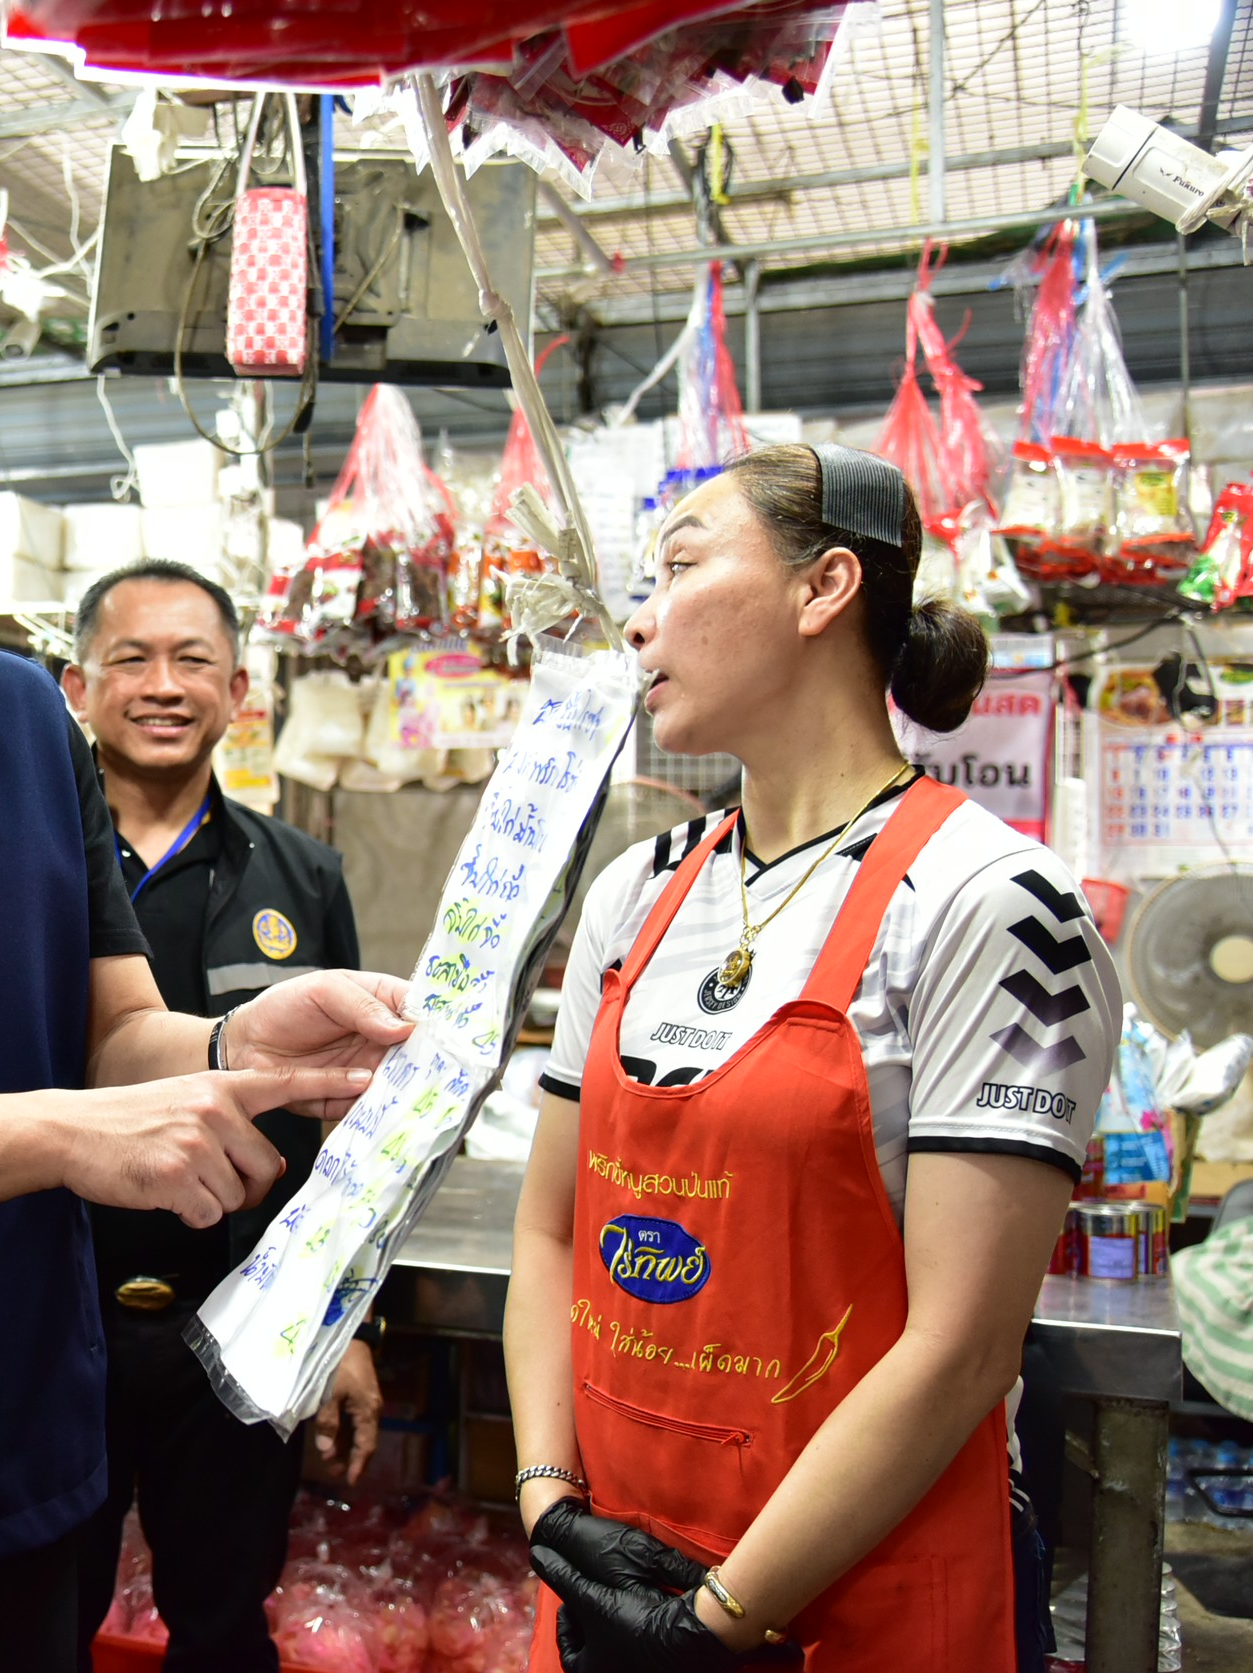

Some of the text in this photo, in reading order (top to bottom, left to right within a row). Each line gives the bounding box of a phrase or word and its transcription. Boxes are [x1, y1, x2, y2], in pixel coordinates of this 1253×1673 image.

[650, 1022, 733, 1051] JUST DO IT
[976, 1082, 1034, 1112] JUST
[1032, 1088, 1066, 1119] DO
[638, 1229, 661, 1244] ตรา
